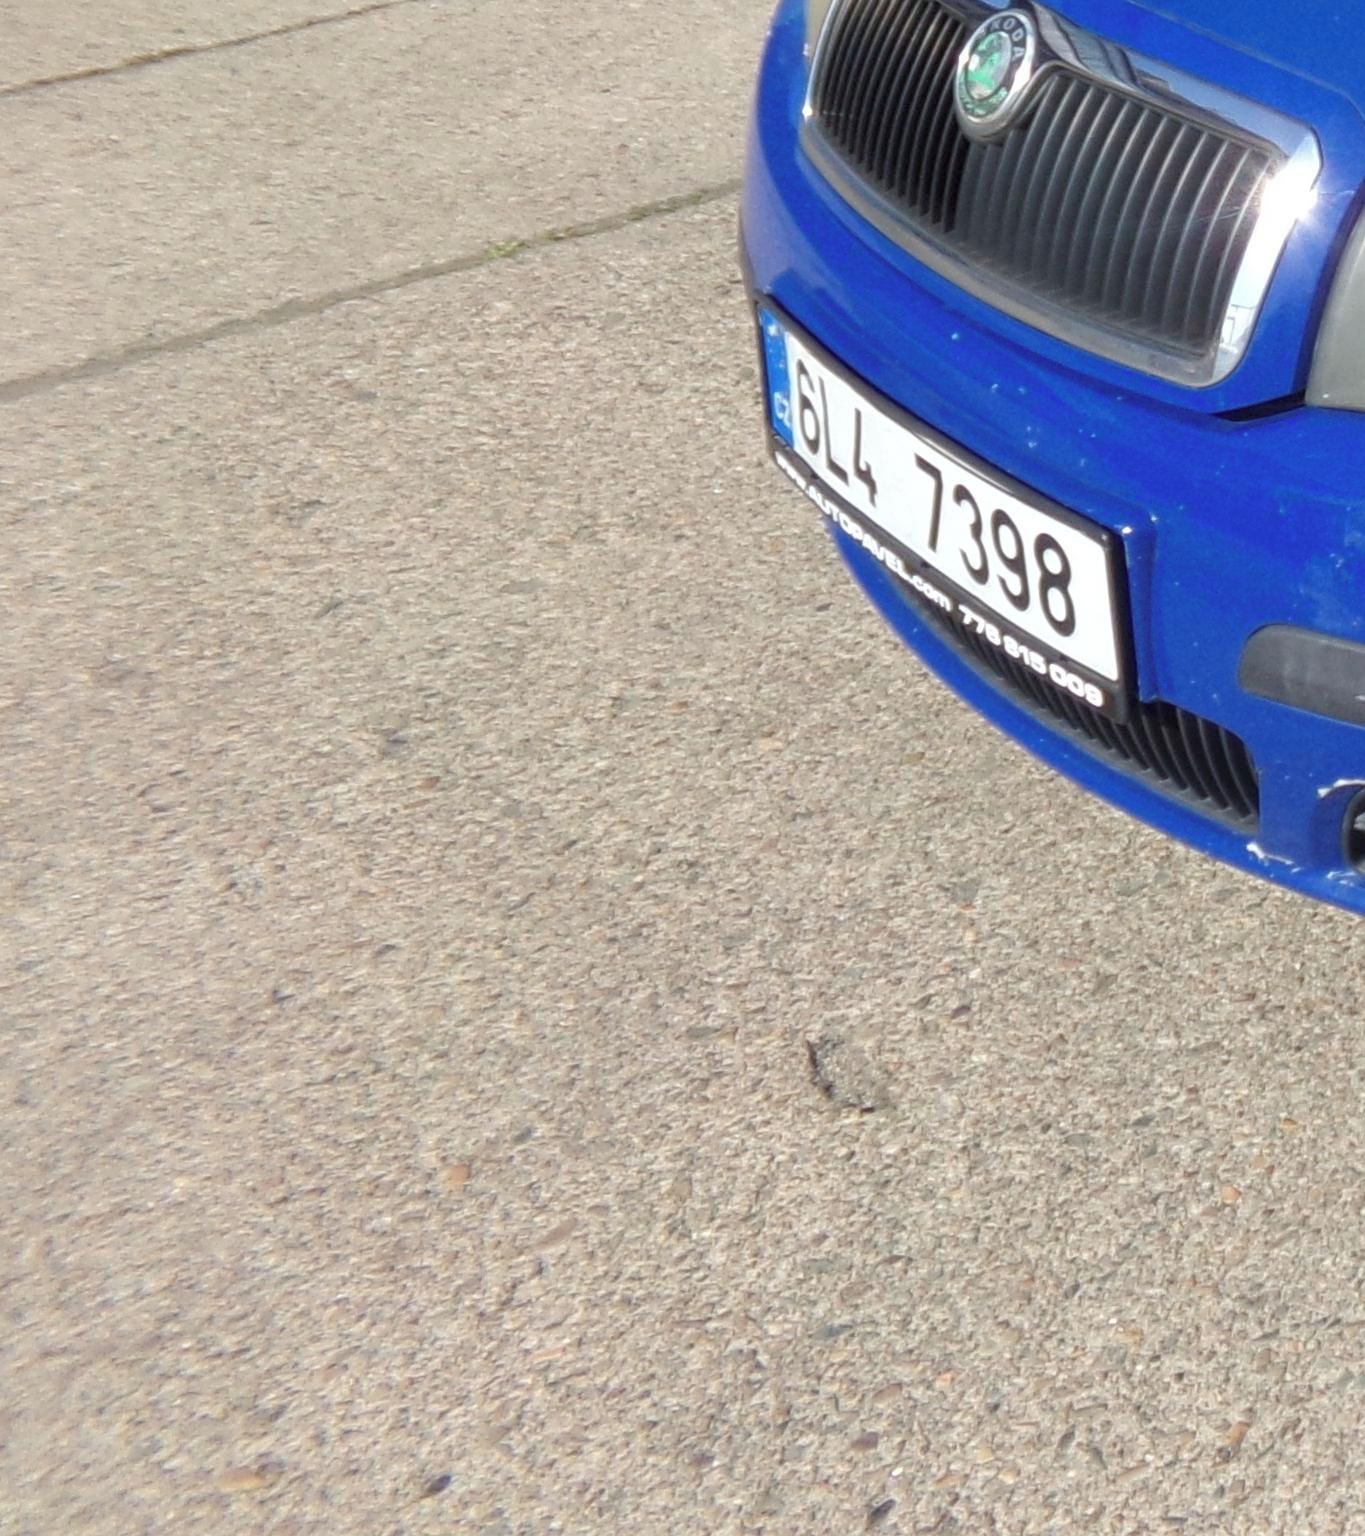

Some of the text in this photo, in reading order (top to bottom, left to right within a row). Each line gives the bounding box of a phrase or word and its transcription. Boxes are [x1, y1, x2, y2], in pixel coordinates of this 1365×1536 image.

[774, 392, 791, 429] CZ
[796, 358, 1076, 638] 6L4 7398
[1003, 635, 1047, 675] 815
